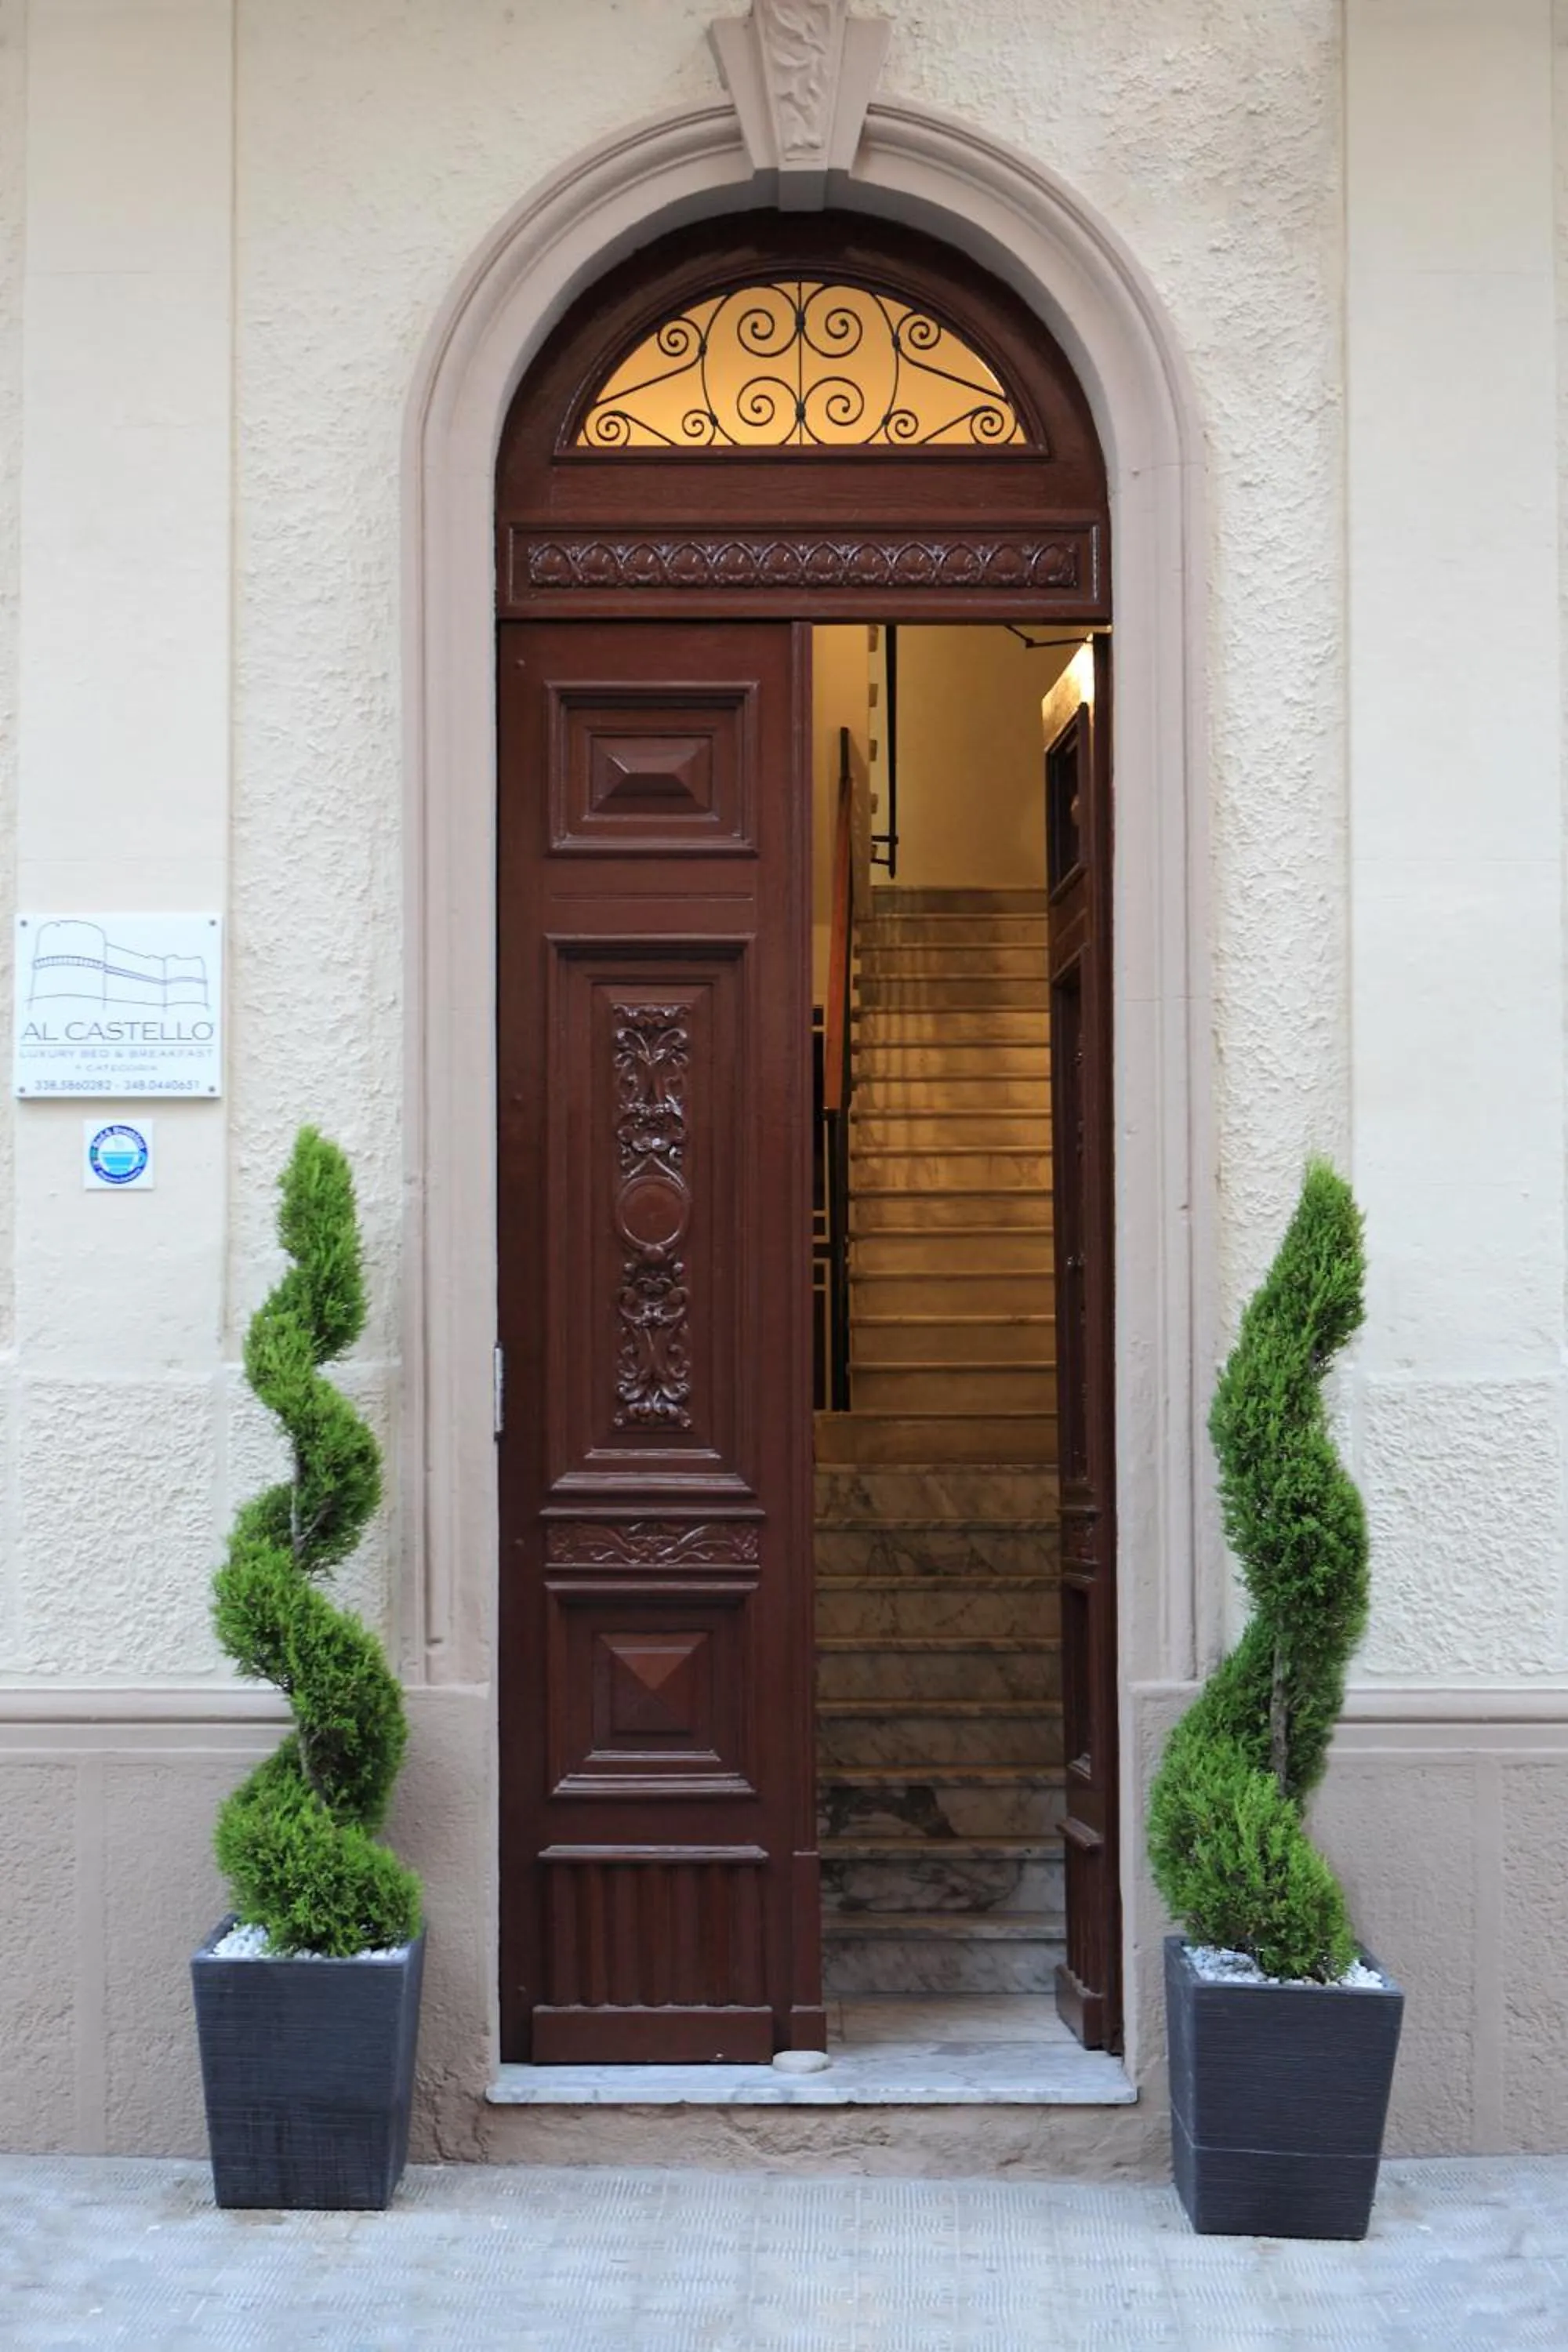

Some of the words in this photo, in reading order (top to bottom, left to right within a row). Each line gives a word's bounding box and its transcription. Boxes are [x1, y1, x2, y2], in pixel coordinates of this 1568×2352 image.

[21, 1022, 60, 1041] AL
[64, 1022, 213, 1041] CASTELLO
[19, 1049, 74, 1058] LUXURY
[81, 1049, 110, 1058] BED
[129, 1049, 213, 1058] BREAKFAST
